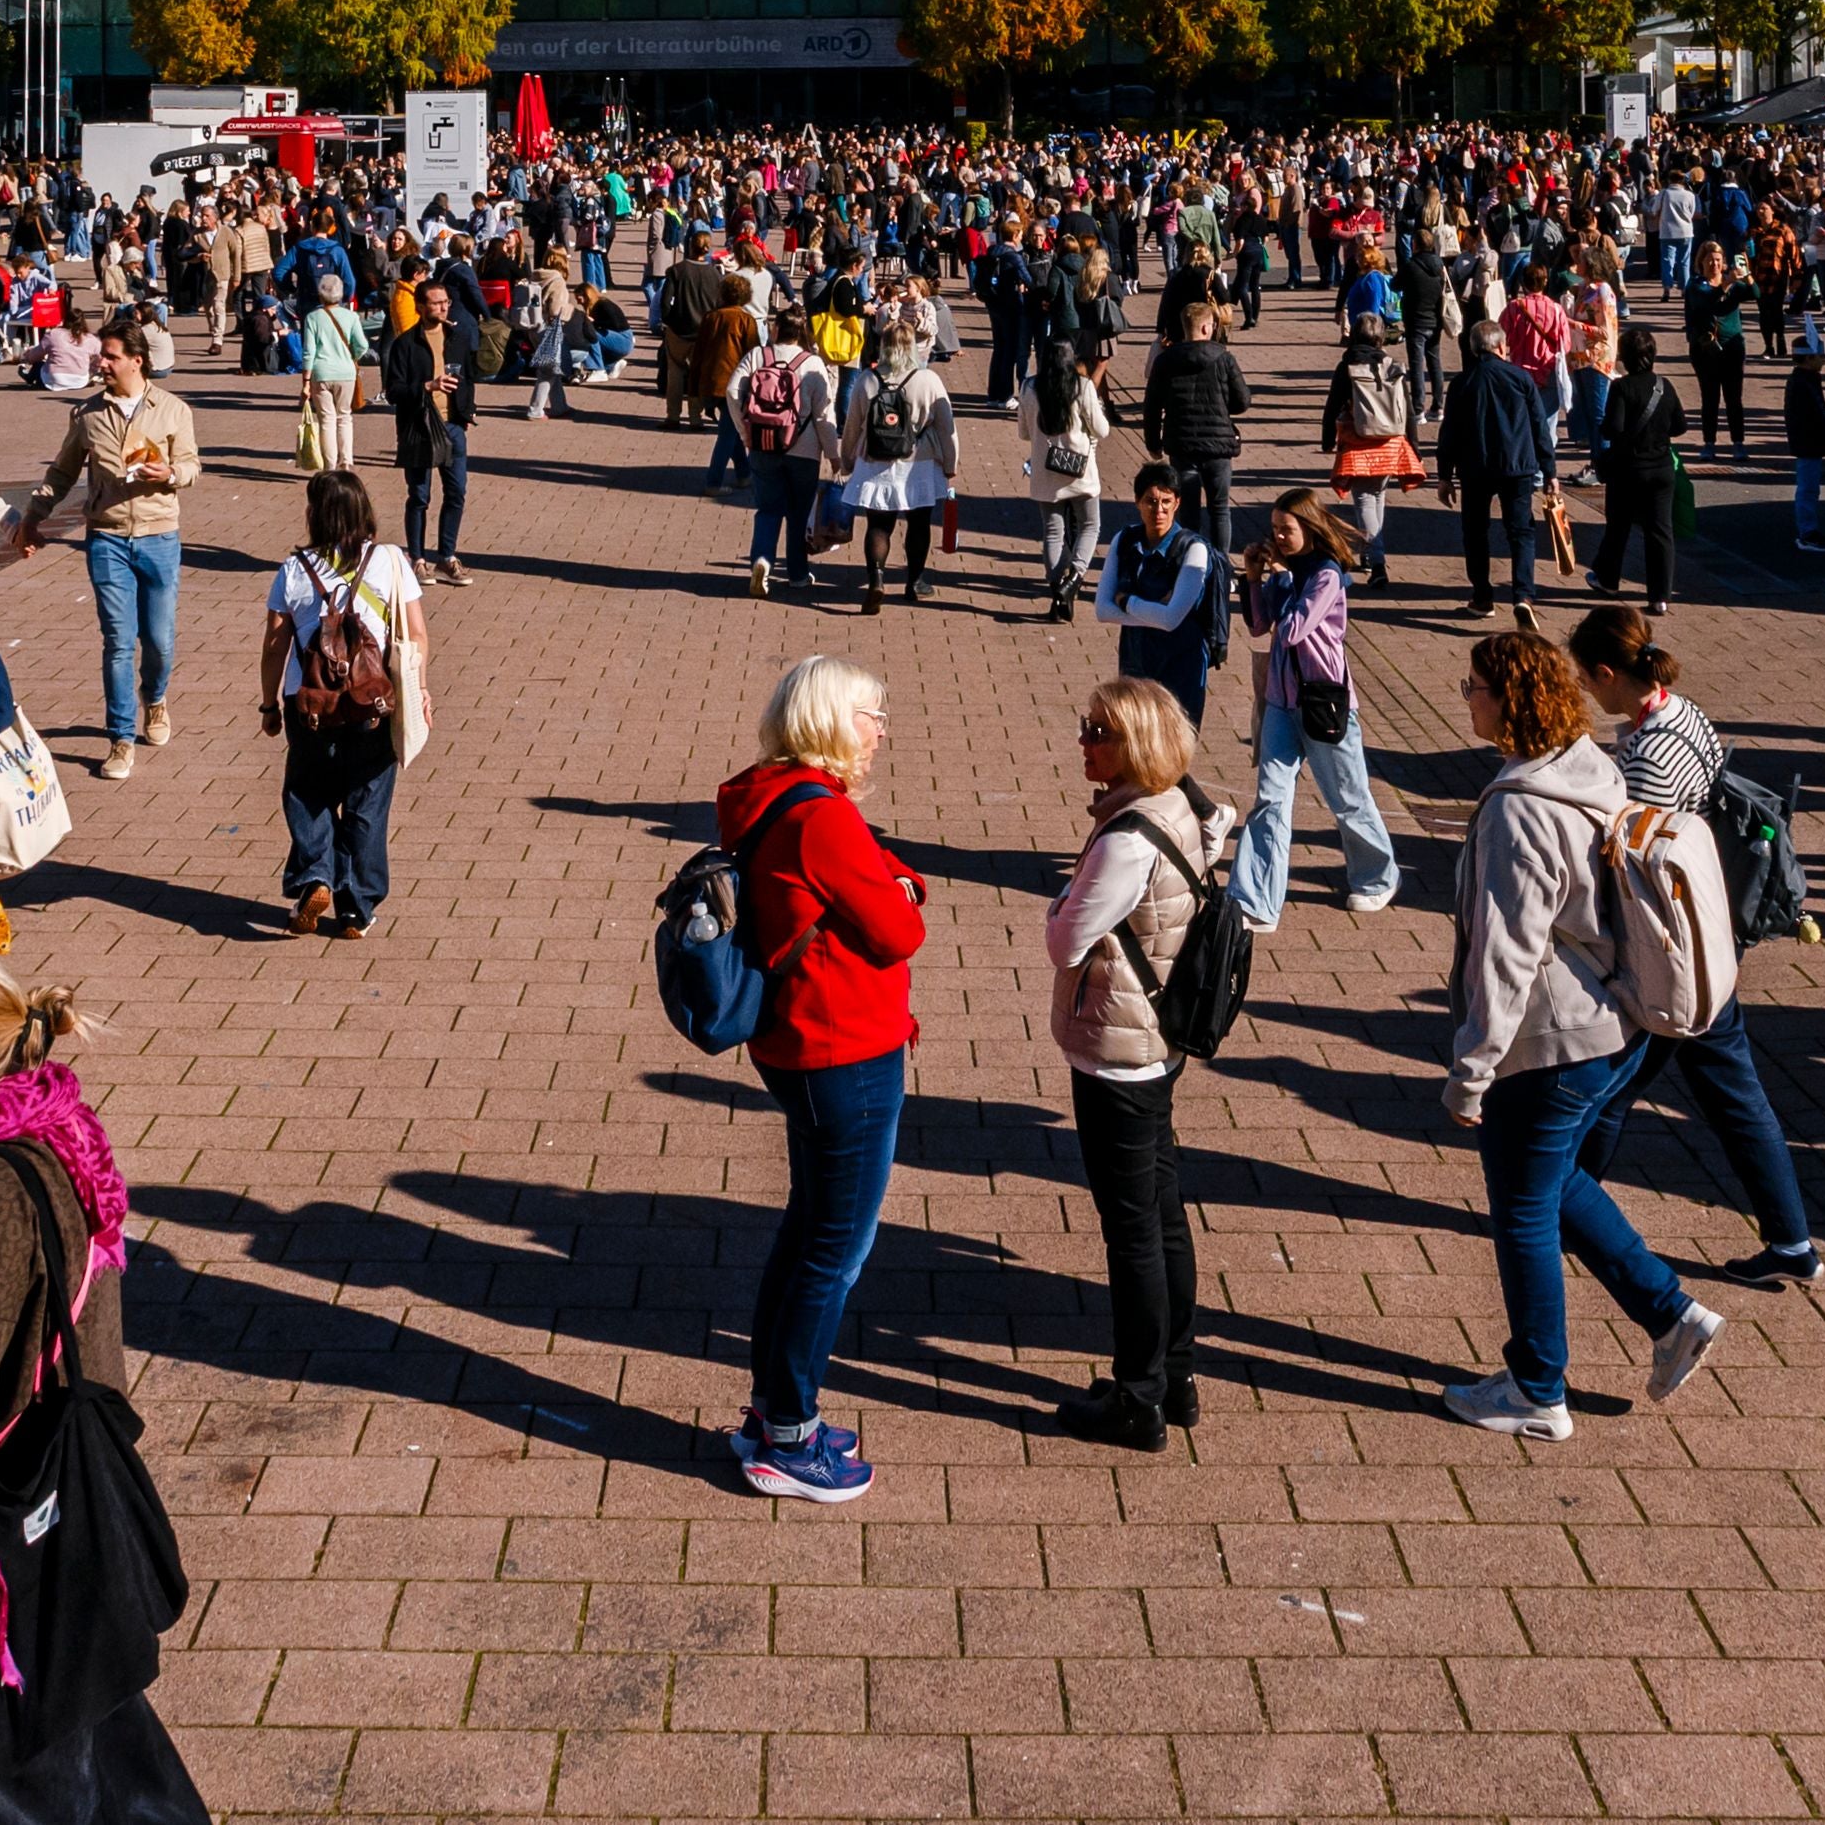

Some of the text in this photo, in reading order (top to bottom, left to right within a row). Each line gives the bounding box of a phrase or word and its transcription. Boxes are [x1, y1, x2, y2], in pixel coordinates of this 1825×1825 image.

[532, 38, 570, 59] auf
[575, 36, 611, 56] der
[616, 35, 782, 55] Literaturbühne
[803, 36, 843, 52] ARD
